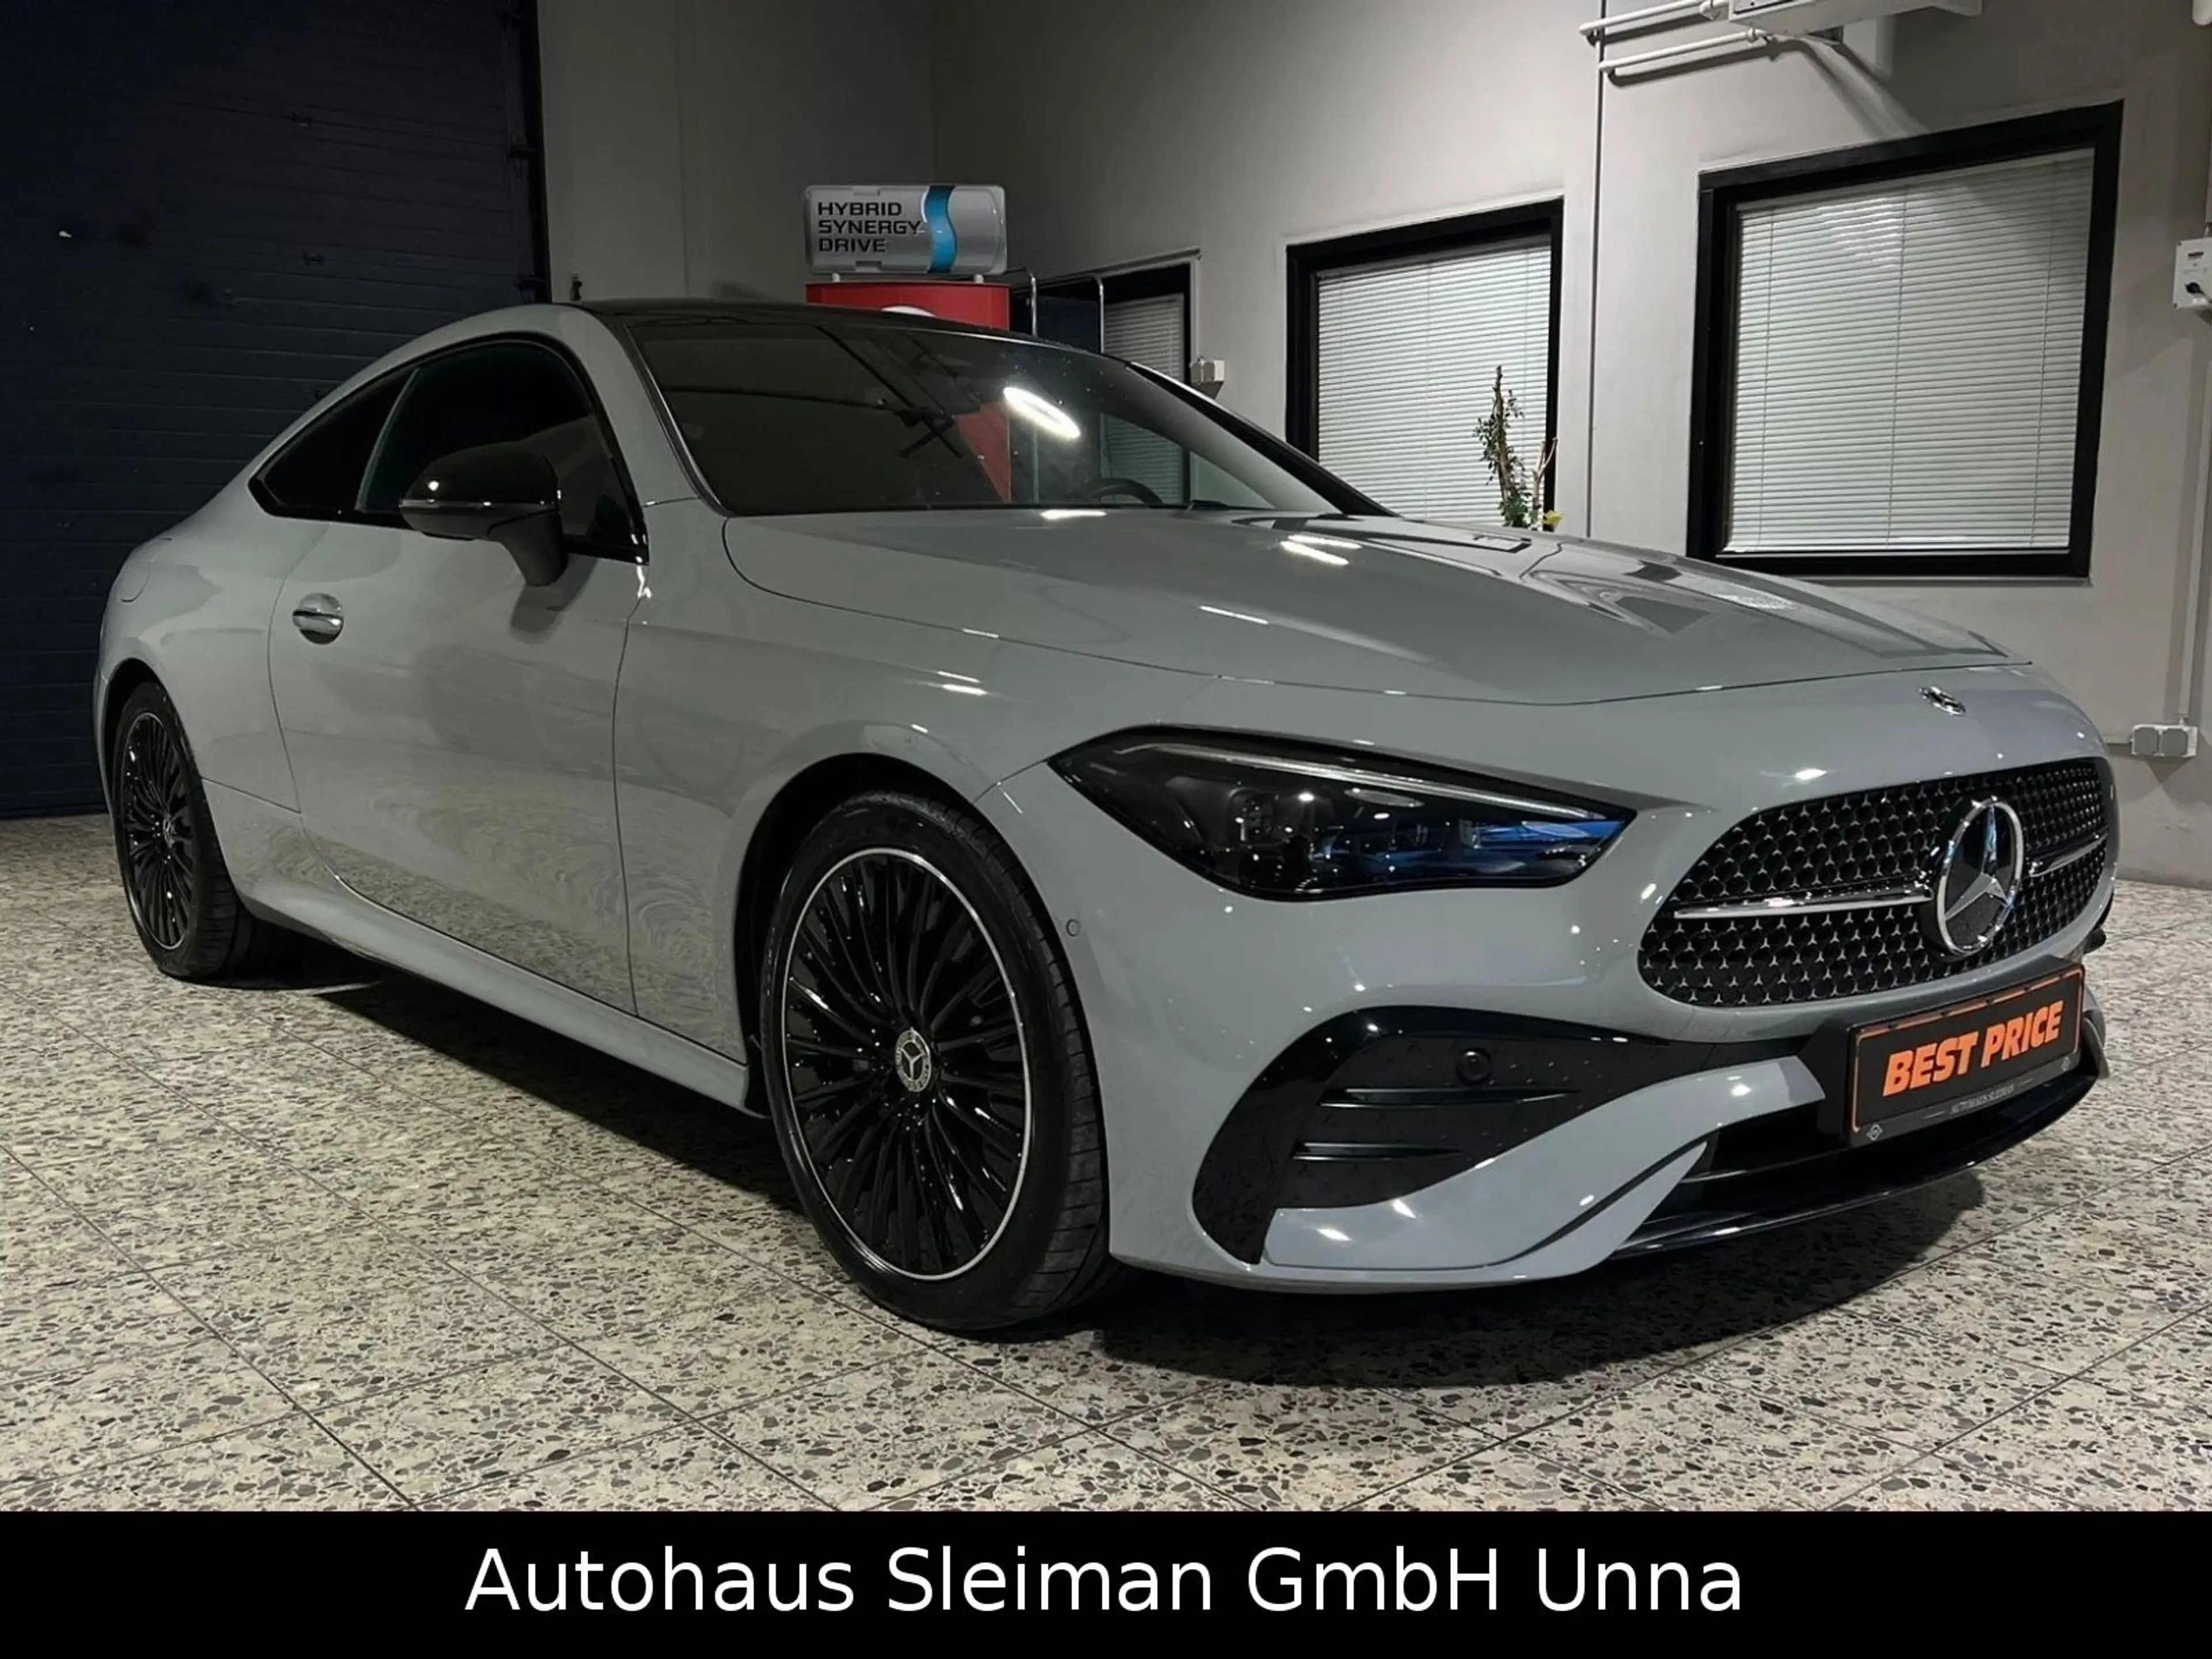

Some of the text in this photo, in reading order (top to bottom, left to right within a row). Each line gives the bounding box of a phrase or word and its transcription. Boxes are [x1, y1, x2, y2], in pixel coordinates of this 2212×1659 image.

[818, 202, 901, 215] HYBRID
[818, 220, 921, 234] SYNERGY
[819, 238, 886, 252] DRIVE
[1883, 1001, 2063, 1096] BEST PRICE
